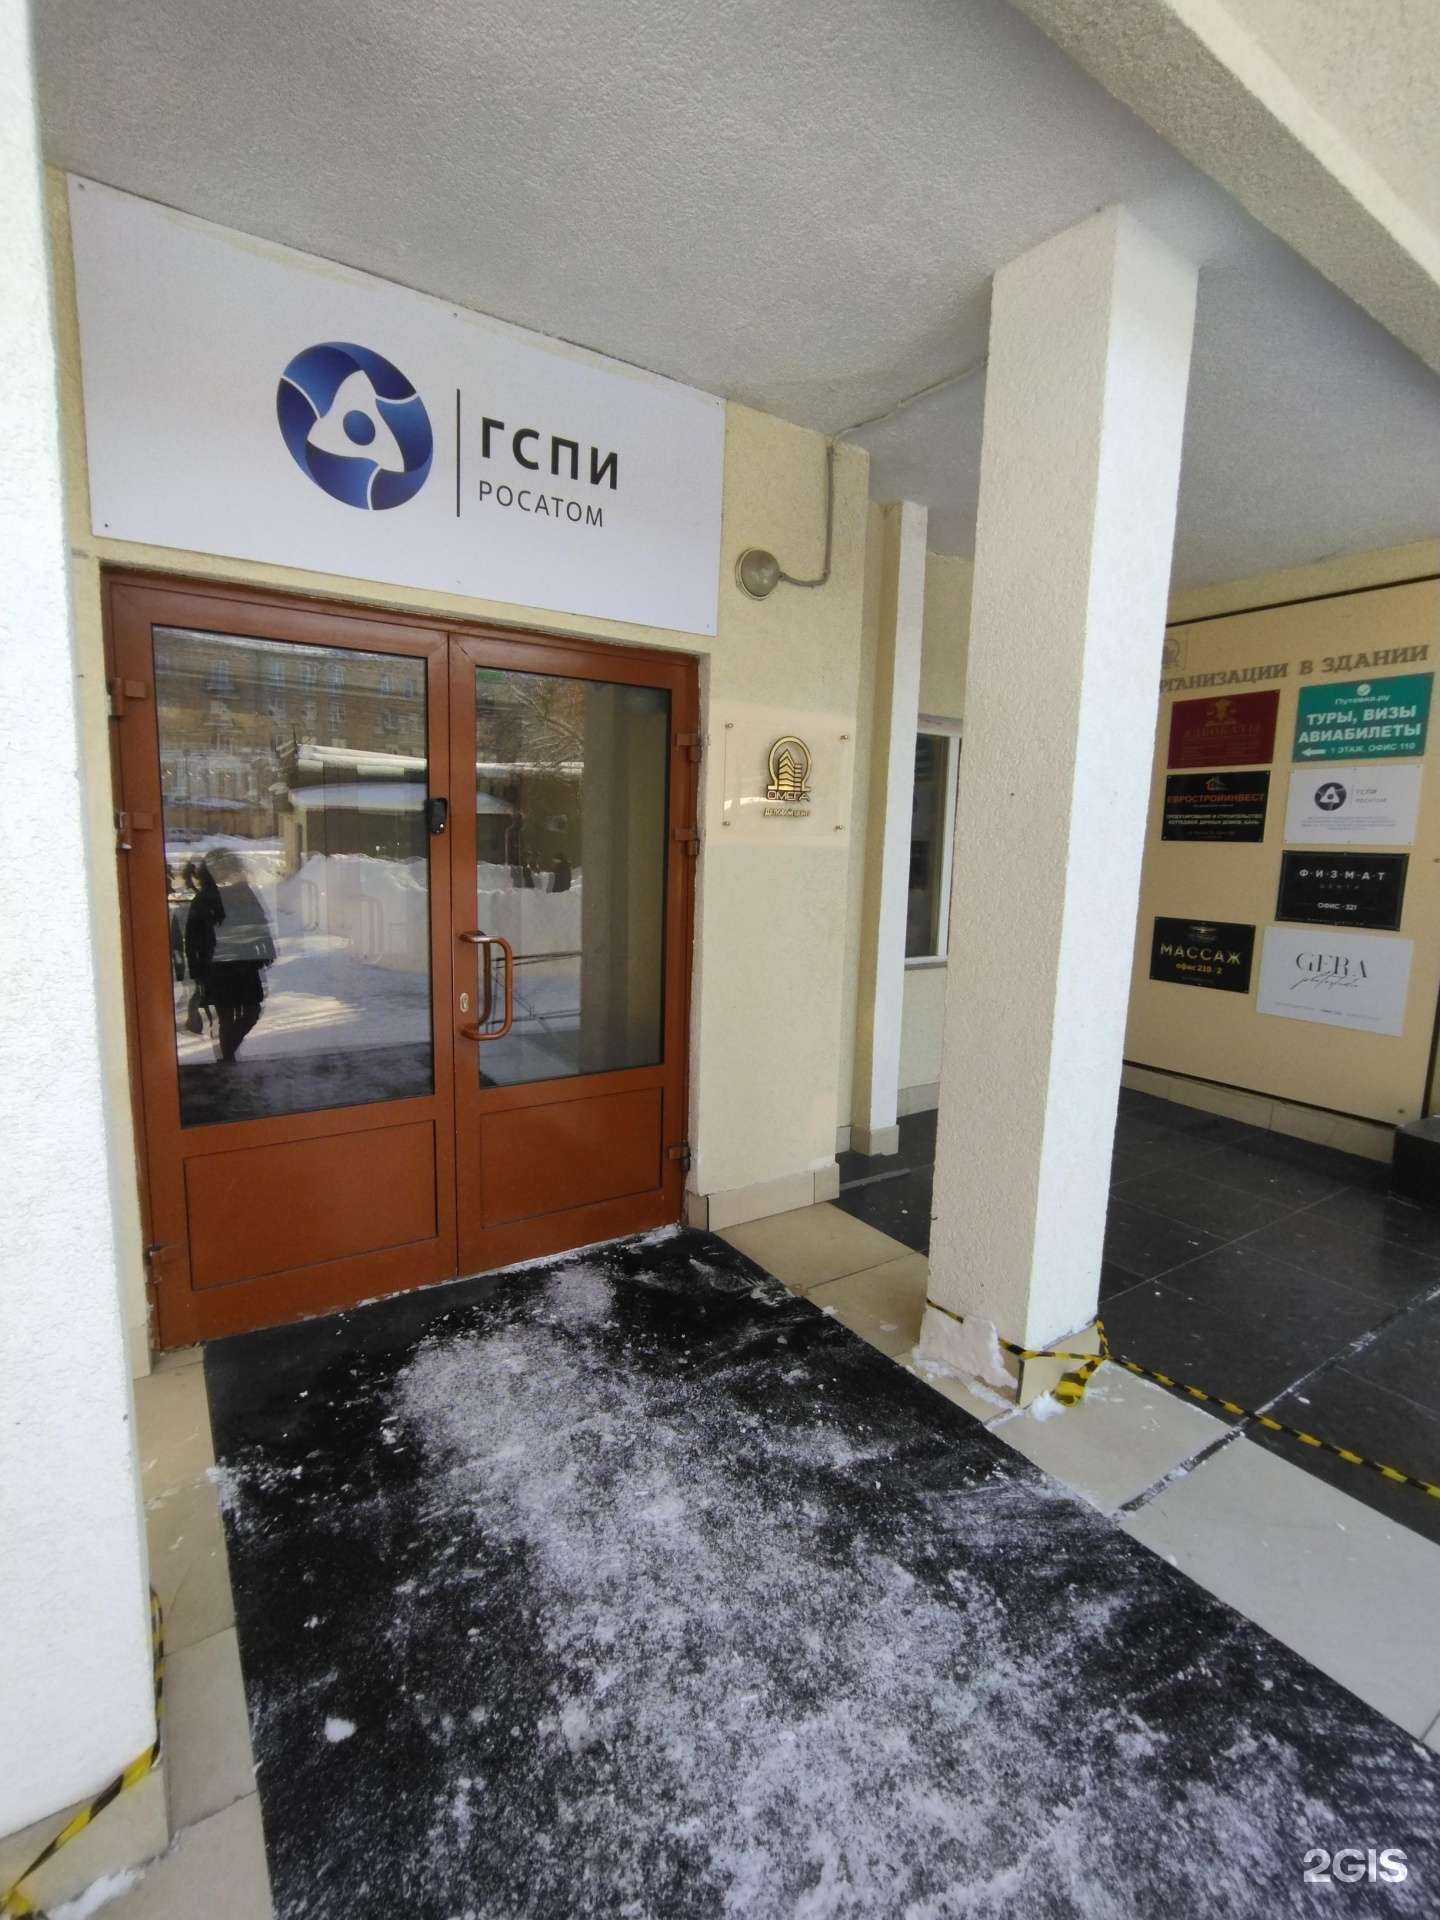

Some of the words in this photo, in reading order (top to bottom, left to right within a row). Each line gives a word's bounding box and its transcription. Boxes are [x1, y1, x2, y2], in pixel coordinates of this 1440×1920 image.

[481, 416, 618, 490] ГСПИ
[479, 479, 603, 527] РОСАТОМ
[1159, 662, 1289, 693] РГАНИЗАЦИИ
[1299, 660, 1313, 675] В
[1321, 645, 1429, 673] ЗДАНИИ
[1306, 711, 1357, 725] ТУРЫ,
[1362, 705, 1417, 721] ВИЗЫ
[1299, 723, 1422, 743] АВИАБИЛЕТЫ
[1368, 743, 1397, 752] ОФИС
[767, 790, 810, 801] ОМЕГА
[1160, 943, 1241, 965] МАССАЖ
